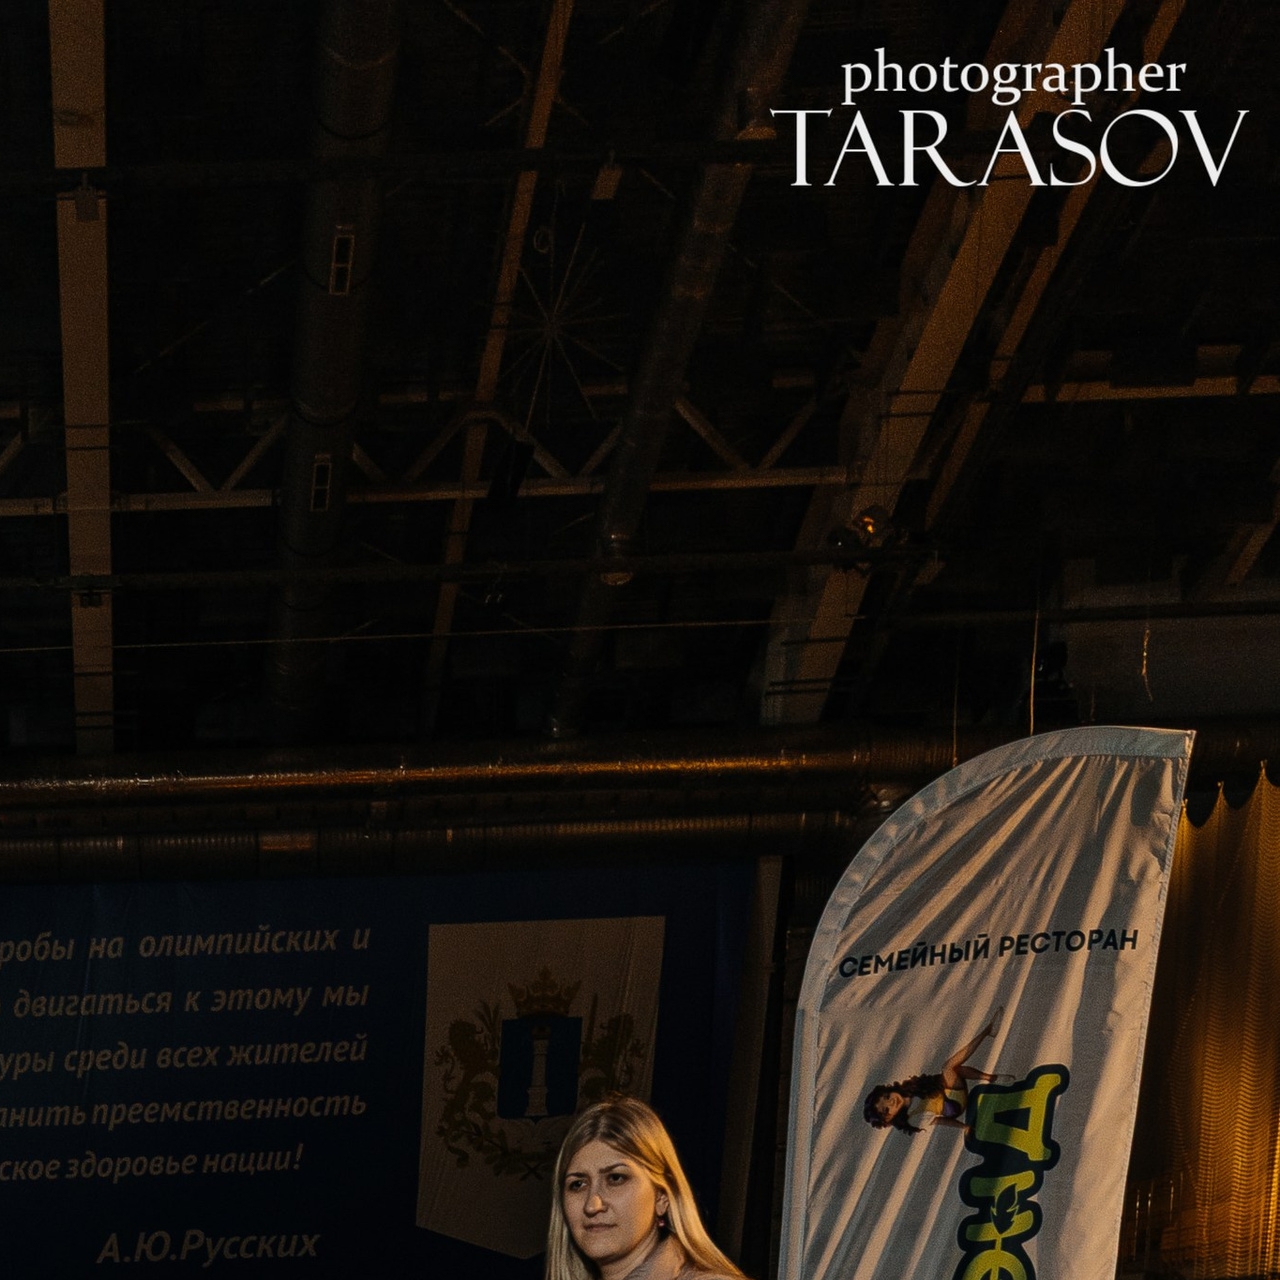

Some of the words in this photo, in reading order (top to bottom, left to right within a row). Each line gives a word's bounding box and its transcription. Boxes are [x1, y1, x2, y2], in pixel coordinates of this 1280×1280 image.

[89, 936, 124, 959] на
[139, 924, 339, 958] олимпийских
[352, 928, 371, 950] и
[838, 934, 991, 979] СЕМЕЙНЫЙ
[998, 928, 1139, 957] РЕСТОРАН
[13, 989, 172, 1018] двигаться
[184, 991, 201, 1012] к
[210, 987, 312, 1016] этому
[322, 985, 370, 1007] мы
[64, 1041, 147, 1078] среди
[156, 1046, 220, 1069] всех
[226, 1033, 368, 1066] жителей
[91, 1095, 367, 1131] преемственность
[65, 1150, 198, 1184] здоровье
[202, 1142, 304, 1176] нации!
